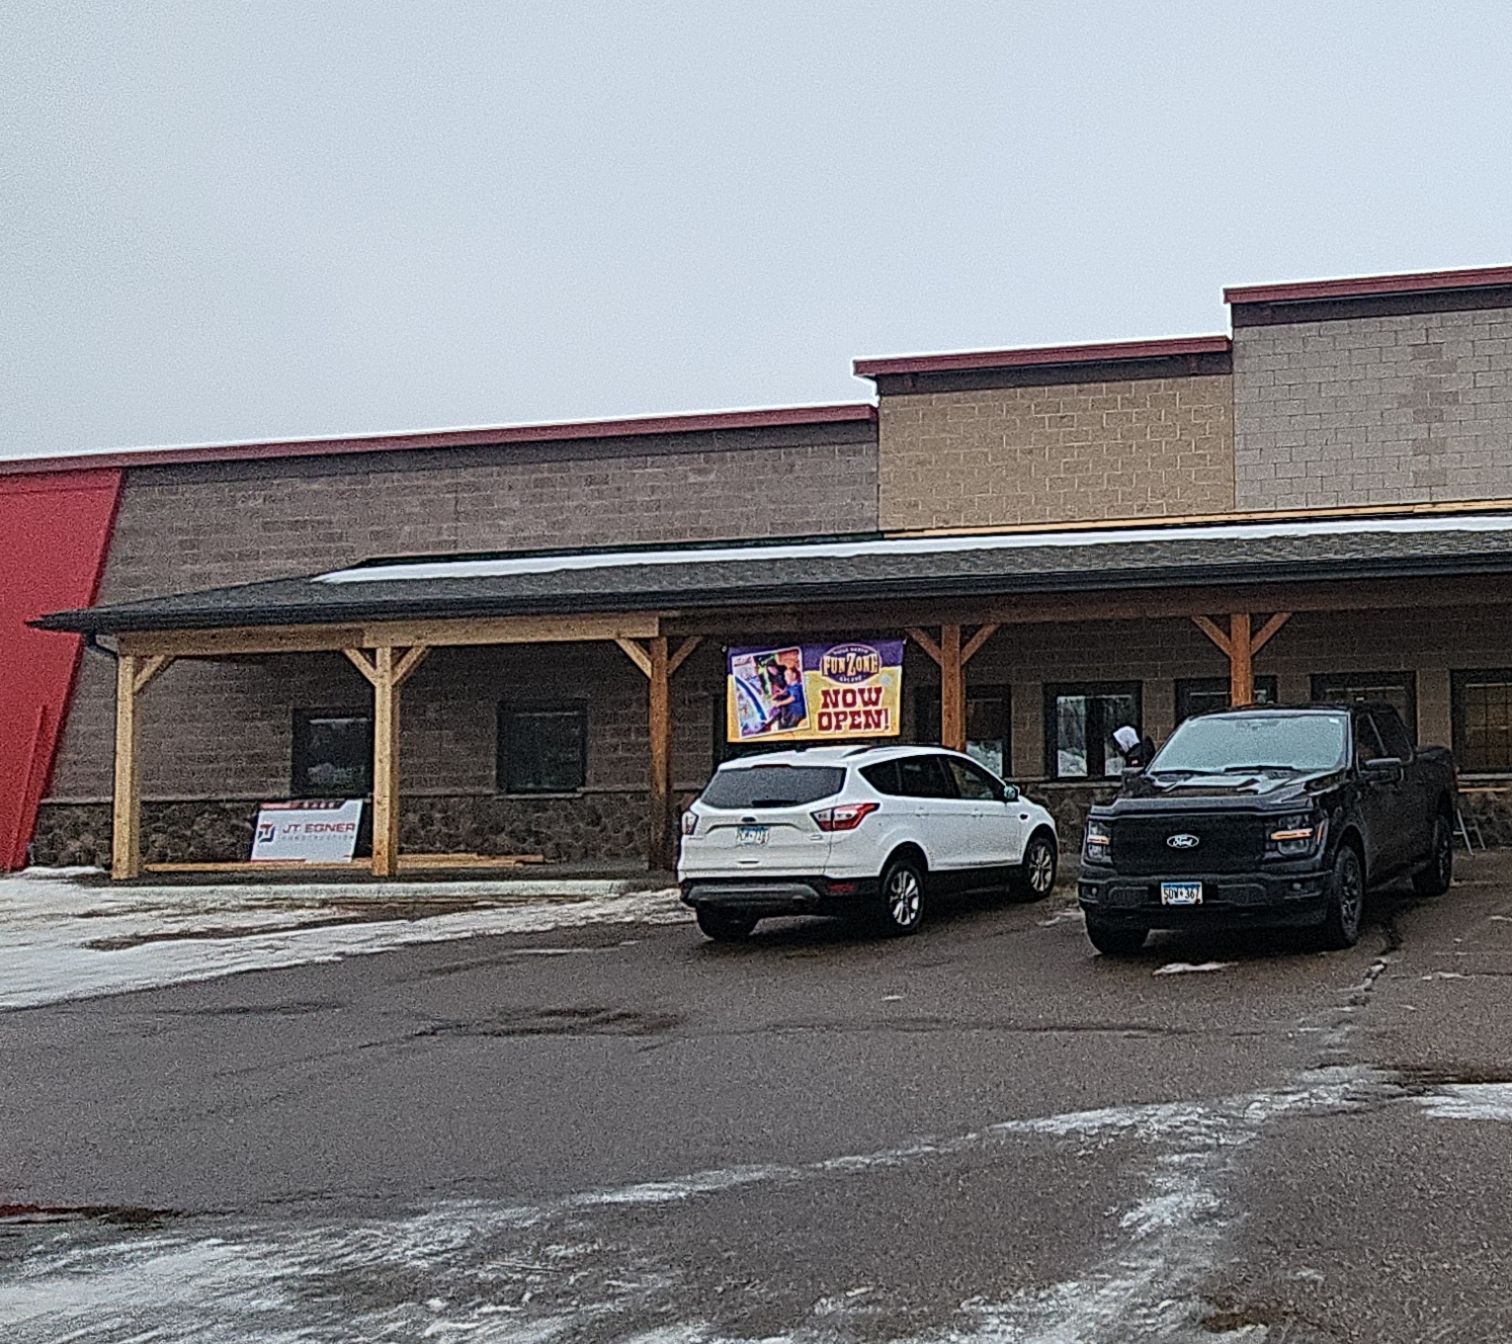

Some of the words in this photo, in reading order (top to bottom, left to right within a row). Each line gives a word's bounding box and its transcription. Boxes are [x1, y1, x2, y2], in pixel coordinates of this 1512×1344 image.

[821, 687, 882, 709] NOW
[818, 708, 889, 731] OPEN!
[305, 822, 356, 833] EGNER
